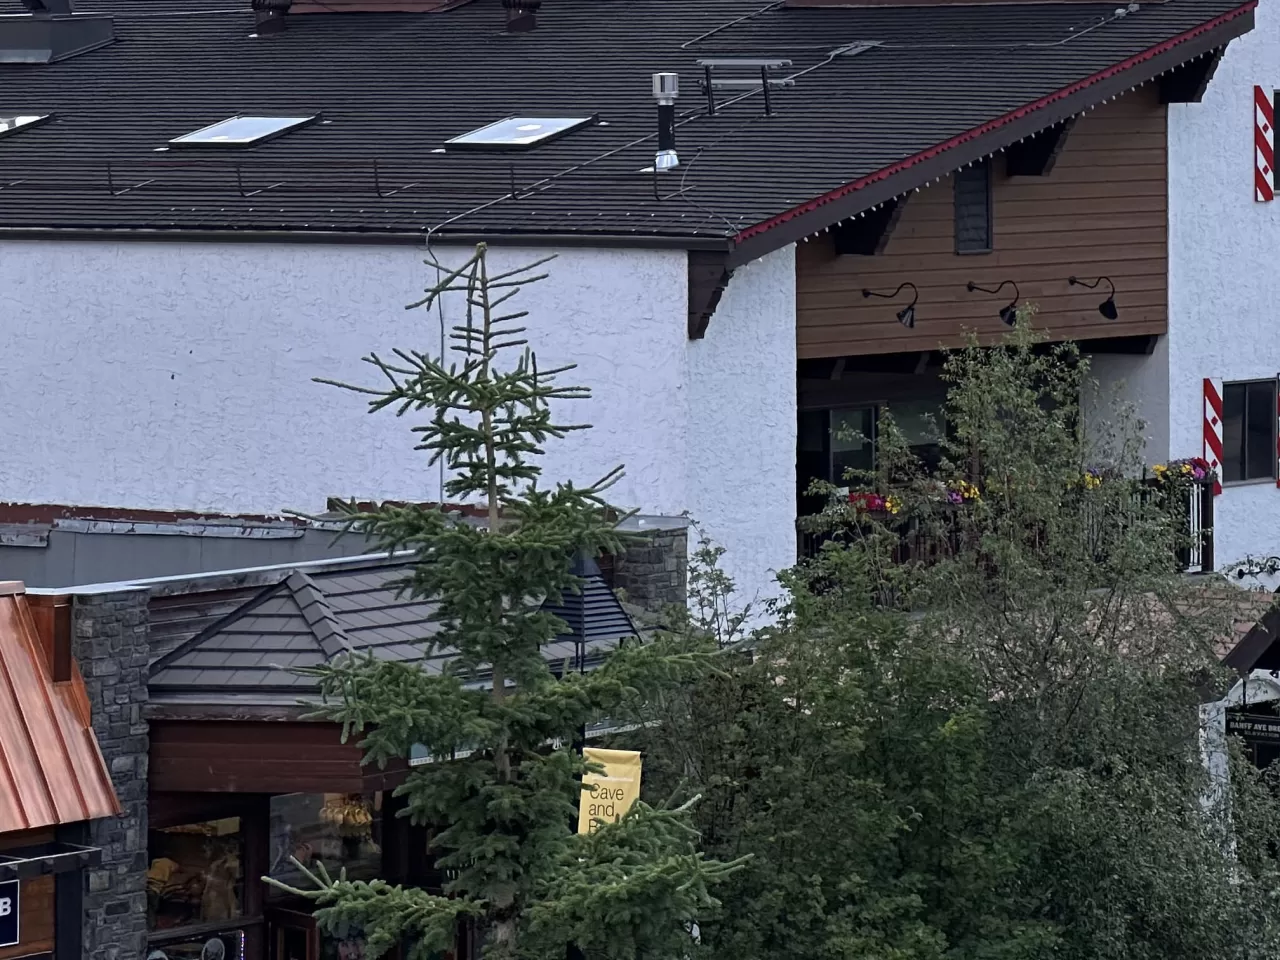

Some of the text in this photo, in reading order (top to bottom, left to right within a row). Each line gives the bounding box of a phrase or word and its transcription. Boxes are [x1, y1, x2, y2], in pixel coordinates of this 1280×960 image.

[1230, 721, 1252, 730] BANFF
[590, 783, 624, 801] Cave
[588, 802, 615, 817] and
